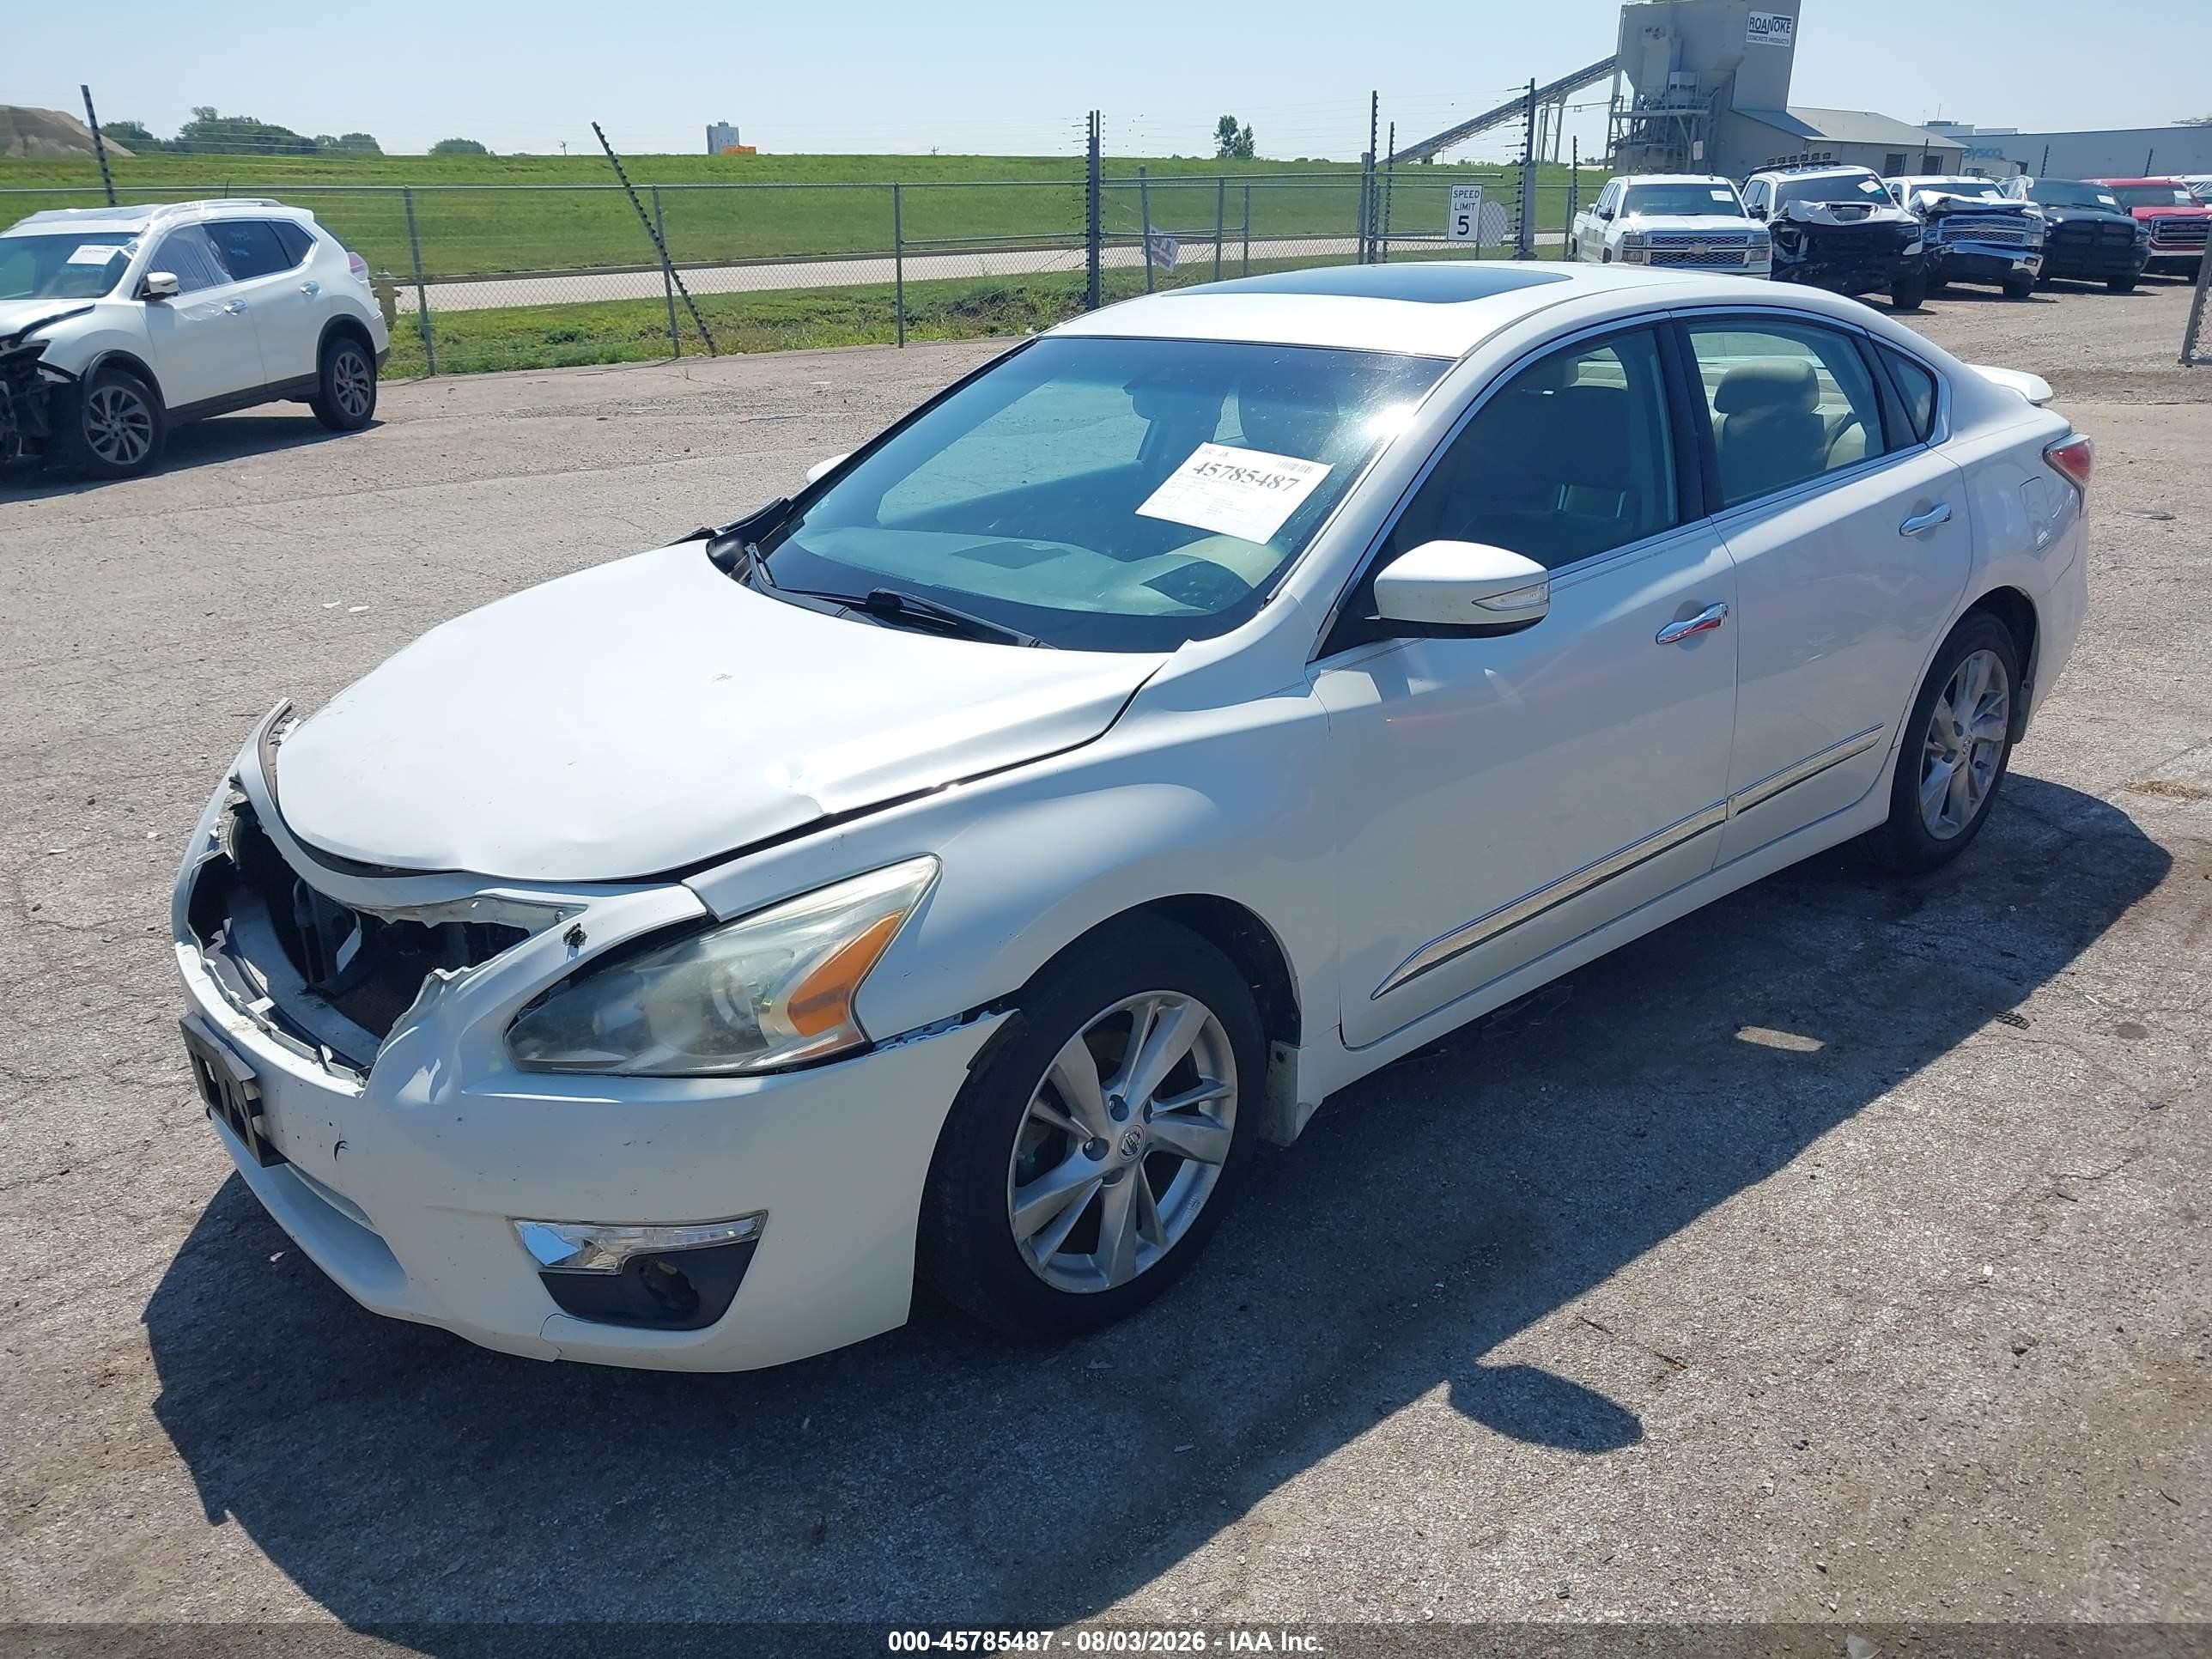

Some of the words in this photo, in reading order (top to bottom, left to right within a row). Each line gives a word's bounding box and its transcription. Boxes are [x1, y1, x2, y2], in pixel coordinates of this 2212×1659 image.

[1748, 16, 1792, 33] ROANOKE
[1453, 190, 1480, 198] SPEED
[1454, 203, 1476, 211] LIMIT
[1456, 215, 1470, 236] 5
[1193, 461, 1301, 492] 45785487
